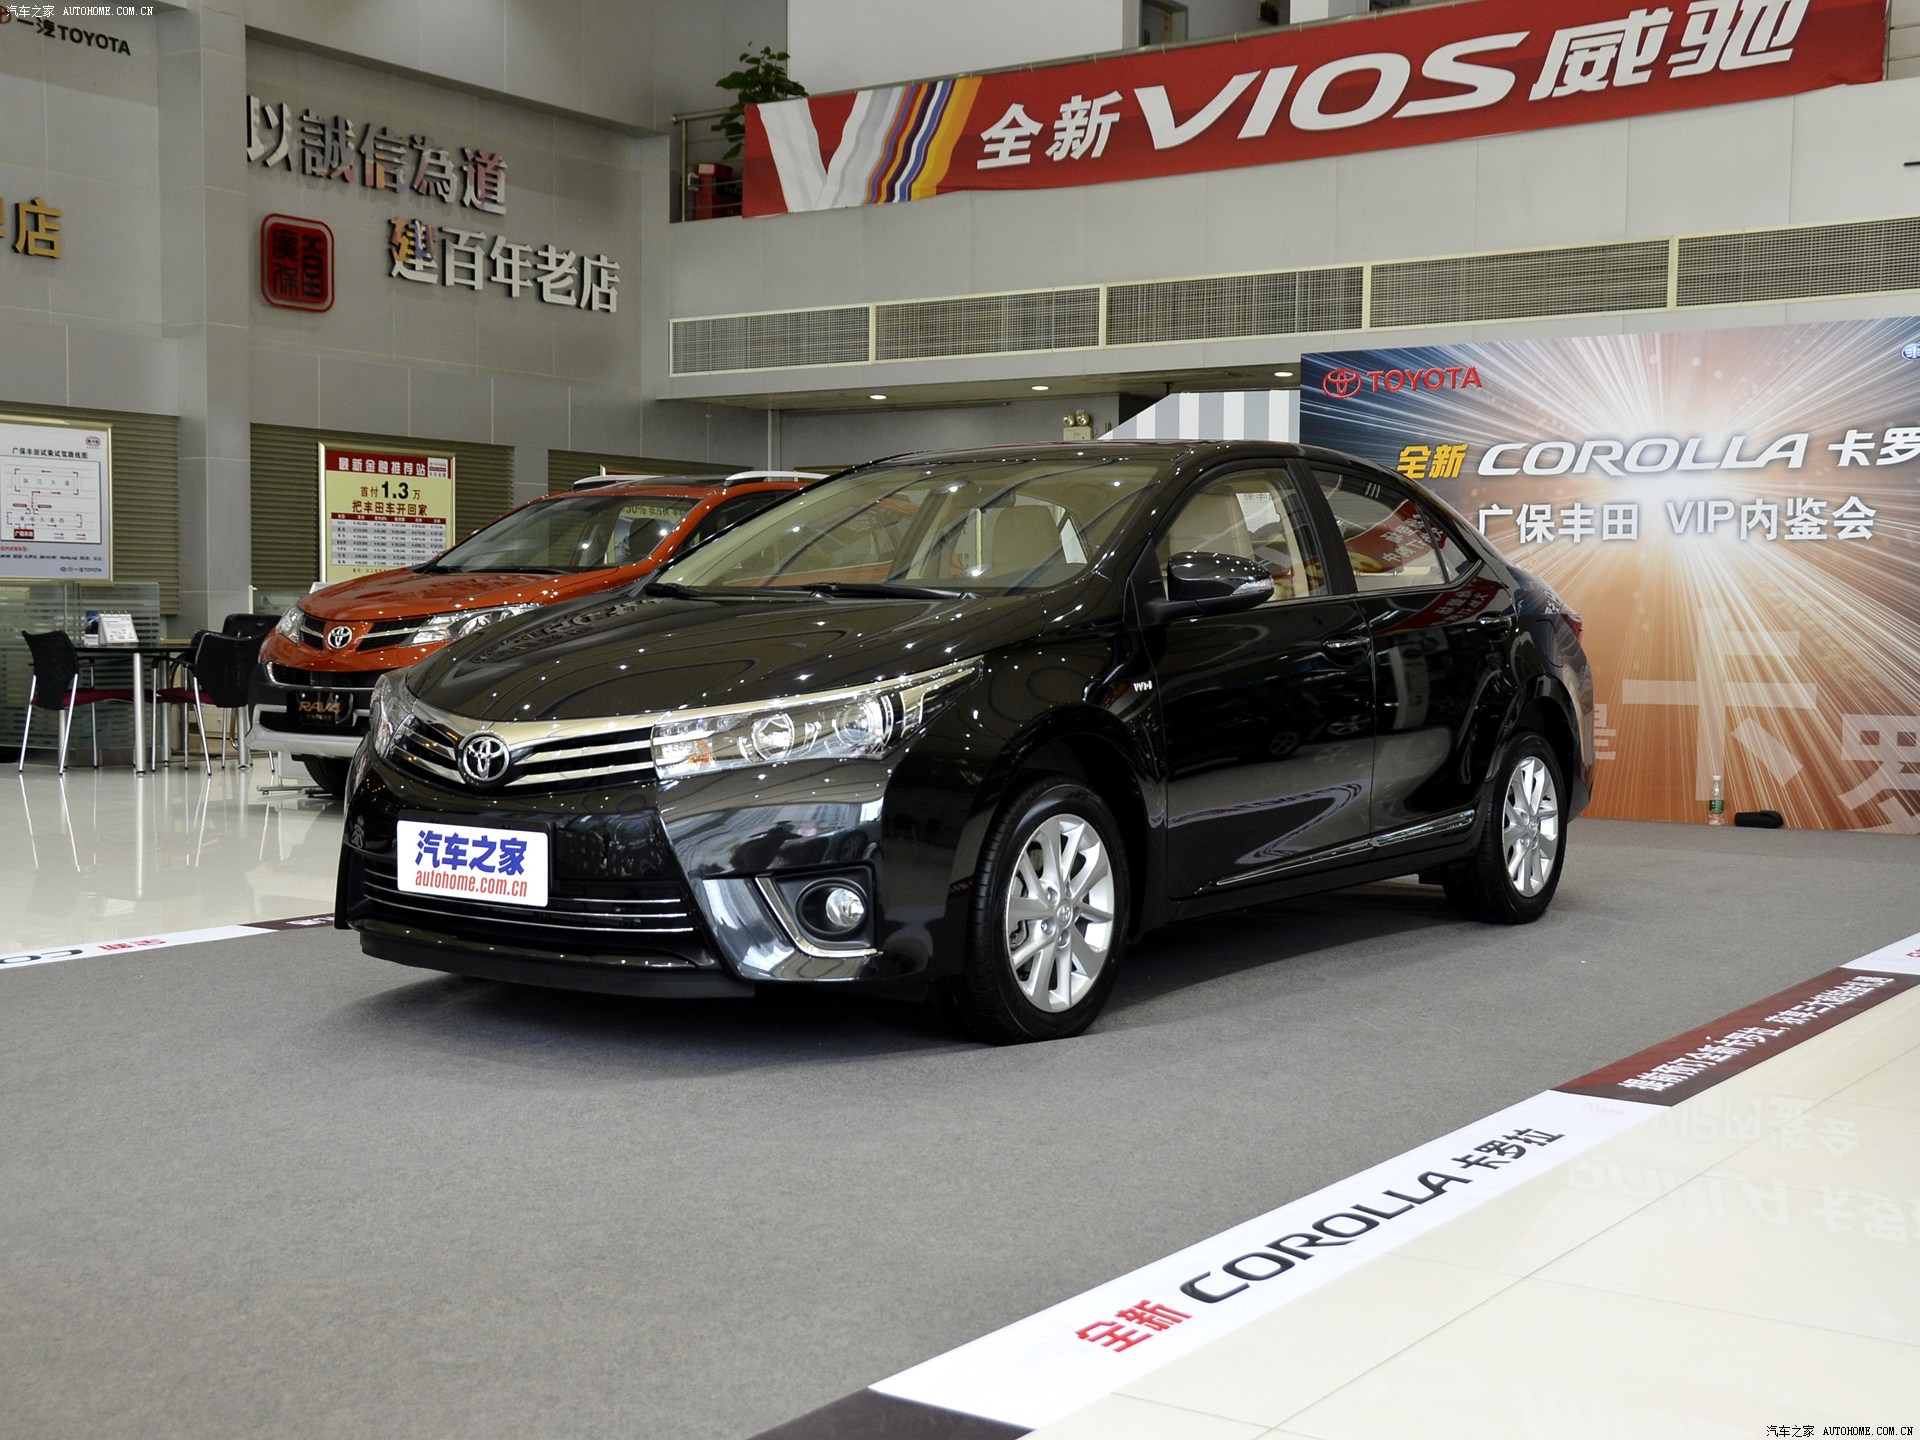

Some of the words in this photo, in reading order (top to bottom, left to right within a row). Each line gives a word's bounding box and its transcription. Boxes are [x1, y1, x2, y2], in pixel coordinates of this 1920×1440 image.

[976, 90, 1124, 170] 全新
[1133, 31, 1530, 150] VIOS
[1528, 0, 1809, 101] 威驰
[0, 196, 62, 258] 店
[388, 217, 620, 313] 建百年老店
[1367, 366, 1482, 393] TOYOTA
[1397, 443, 1468, 479] 全新
[1477, 433, 1811, 477] COROLLA
[1827, 426, 1920, 467] 卡罗
[352, 500, 428, 517] 把丰田车开回家
[1477, 503, 1639, 544] 广保丰田
[1666, 495, 1877, 541] VIP内鉴会
[415, 830, 528, 876] 汽车之家
[415, 869, 528, 898] autohome.com.cn
[1075, 1299, 1193, 1353] 全新
[1179, 1169, 1473, 1304] COROLLA
[1450, 1127, 1565, 1171] 卡罗拉
